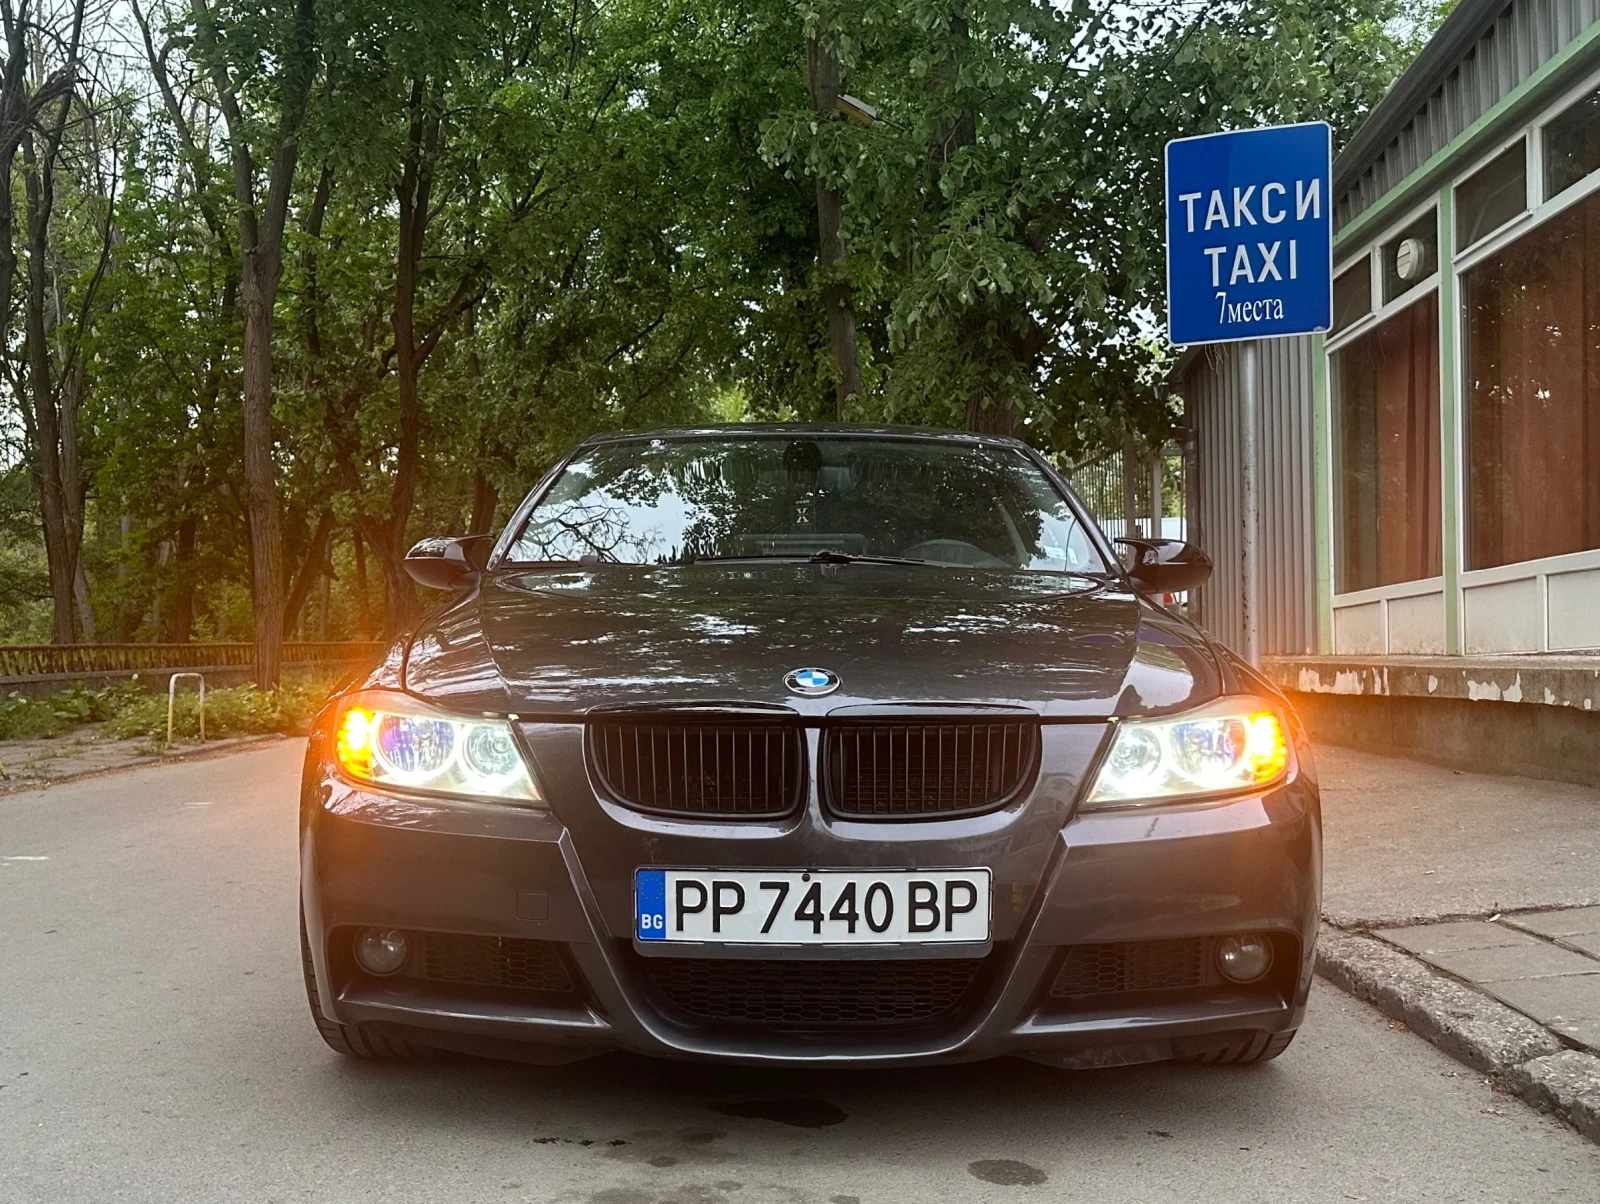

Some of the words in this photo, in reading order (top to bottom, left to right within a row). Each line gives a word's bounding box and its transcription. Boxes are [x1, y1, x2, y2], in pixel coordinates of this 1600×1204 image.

[1178, 178, 1320, 233] ТАКСИ
[1203, 239, 1297, 287] TAXI
[641, 914, 663, 930] BG
[675, 880, 746, 933] PP
[759, 881, 894, 934] 7440
[908, 880, 978, 933] BP
